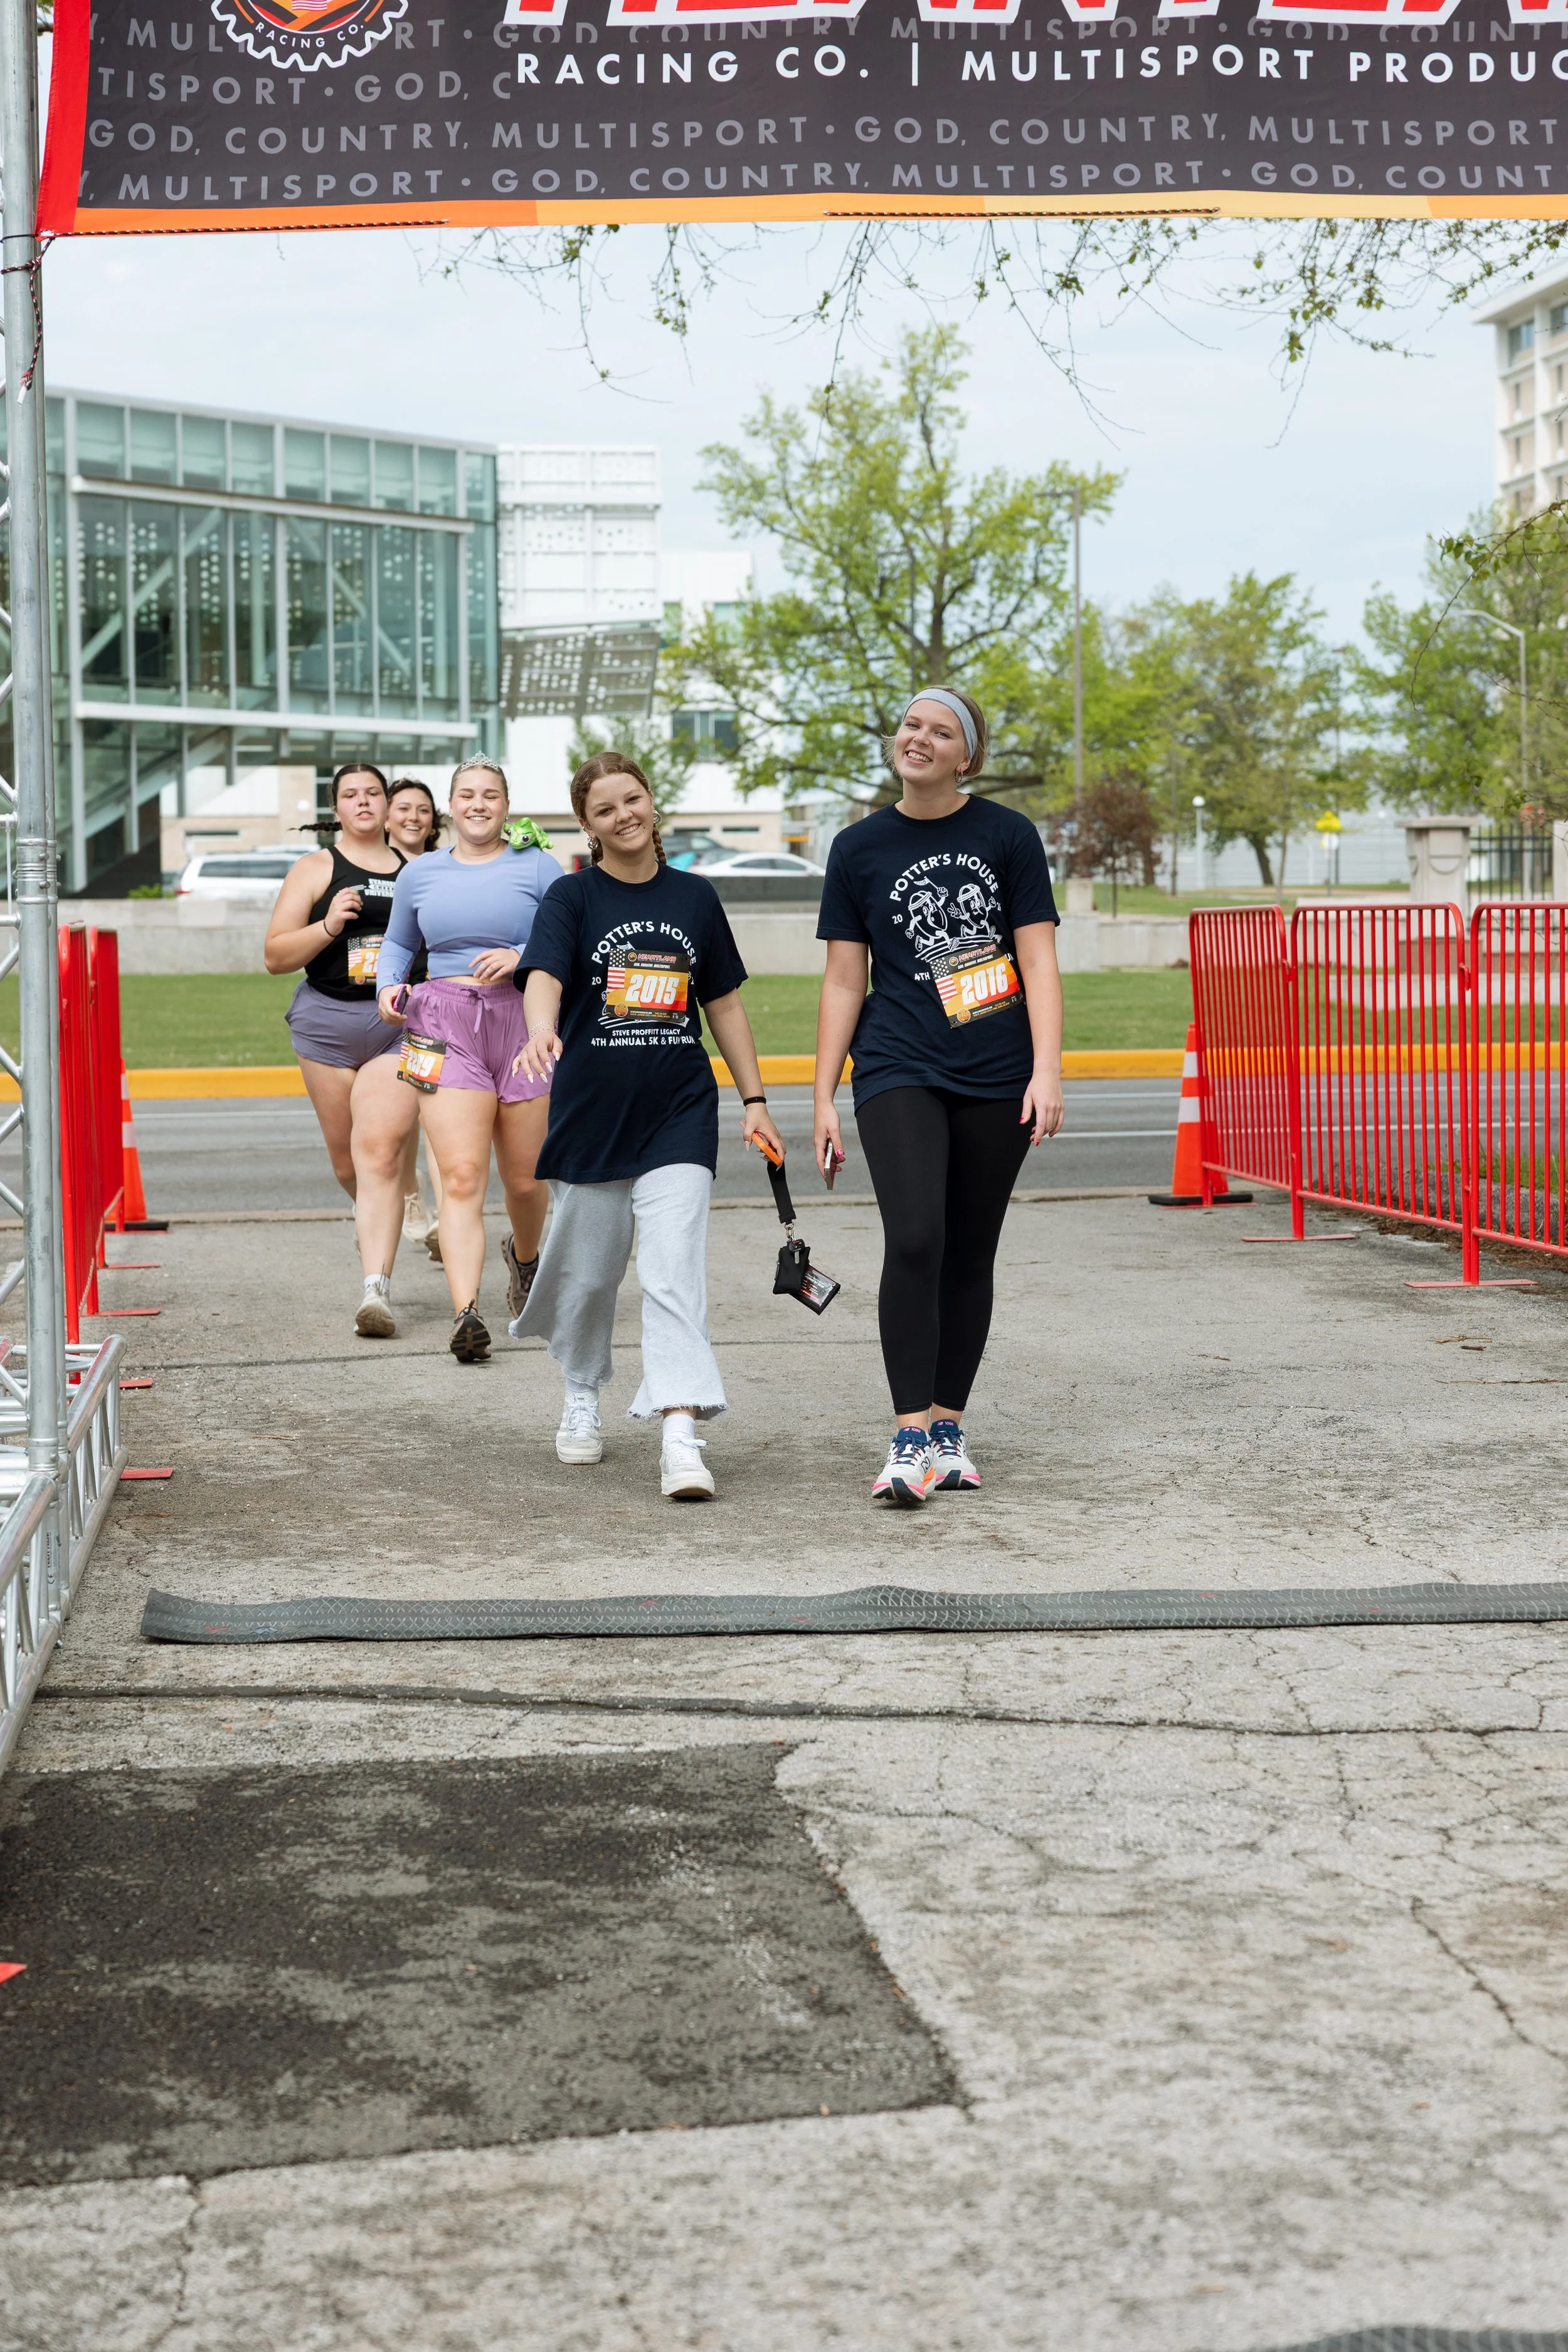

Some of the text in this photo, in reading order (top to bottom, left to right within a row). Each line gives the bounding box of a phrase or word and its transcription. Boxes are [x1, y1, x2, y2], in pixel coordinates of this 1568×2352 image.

[255, 21, 364, 48] RACING CO.
[517, 50, 739, 85] RACING
[775, 44, 869, 79] CO.
[961, 44, 1314, 82] MULTISPORT
[98, 66, 306, 105] TISPORT
[354, 70, 469, 103] GOD,
[88, 113, 1557, 156] GOD, COUNTRY, MULTISPORT GOD, COUNTRY, MULTISPORT
[117, 169, 443, 201] MULTISPORT
[491, 169, 606, 194] GOD,
[629, 162, 869, 192] COUNTRY,
[891, 160, 1204, 189] MULTISPORT
[1251, 161, 1364, 191] GOD,
[889, 853, 999, 902] POTTER'S HOUSE
[892, 914, 903, 924] 20
[591, 921, 697, 967] POTTER'S HOUSE
[637, 953, 677, 962] HEARTLAND
[958, 943, 997, 961] HEARTLAND
[591, 976, 602, 985] 20
[625, 974, 680, 1005] 2015
[914, 972, 930, 982] 4TH
[960, 962, 1009, 1006] 2016
[591, 1037, 607, 1047] 4TH
[608, 1037, 647, 1047] ANNUAL
[648, 1036, 659, 1045] 5K
[660, 1036, 667, 1045] &
